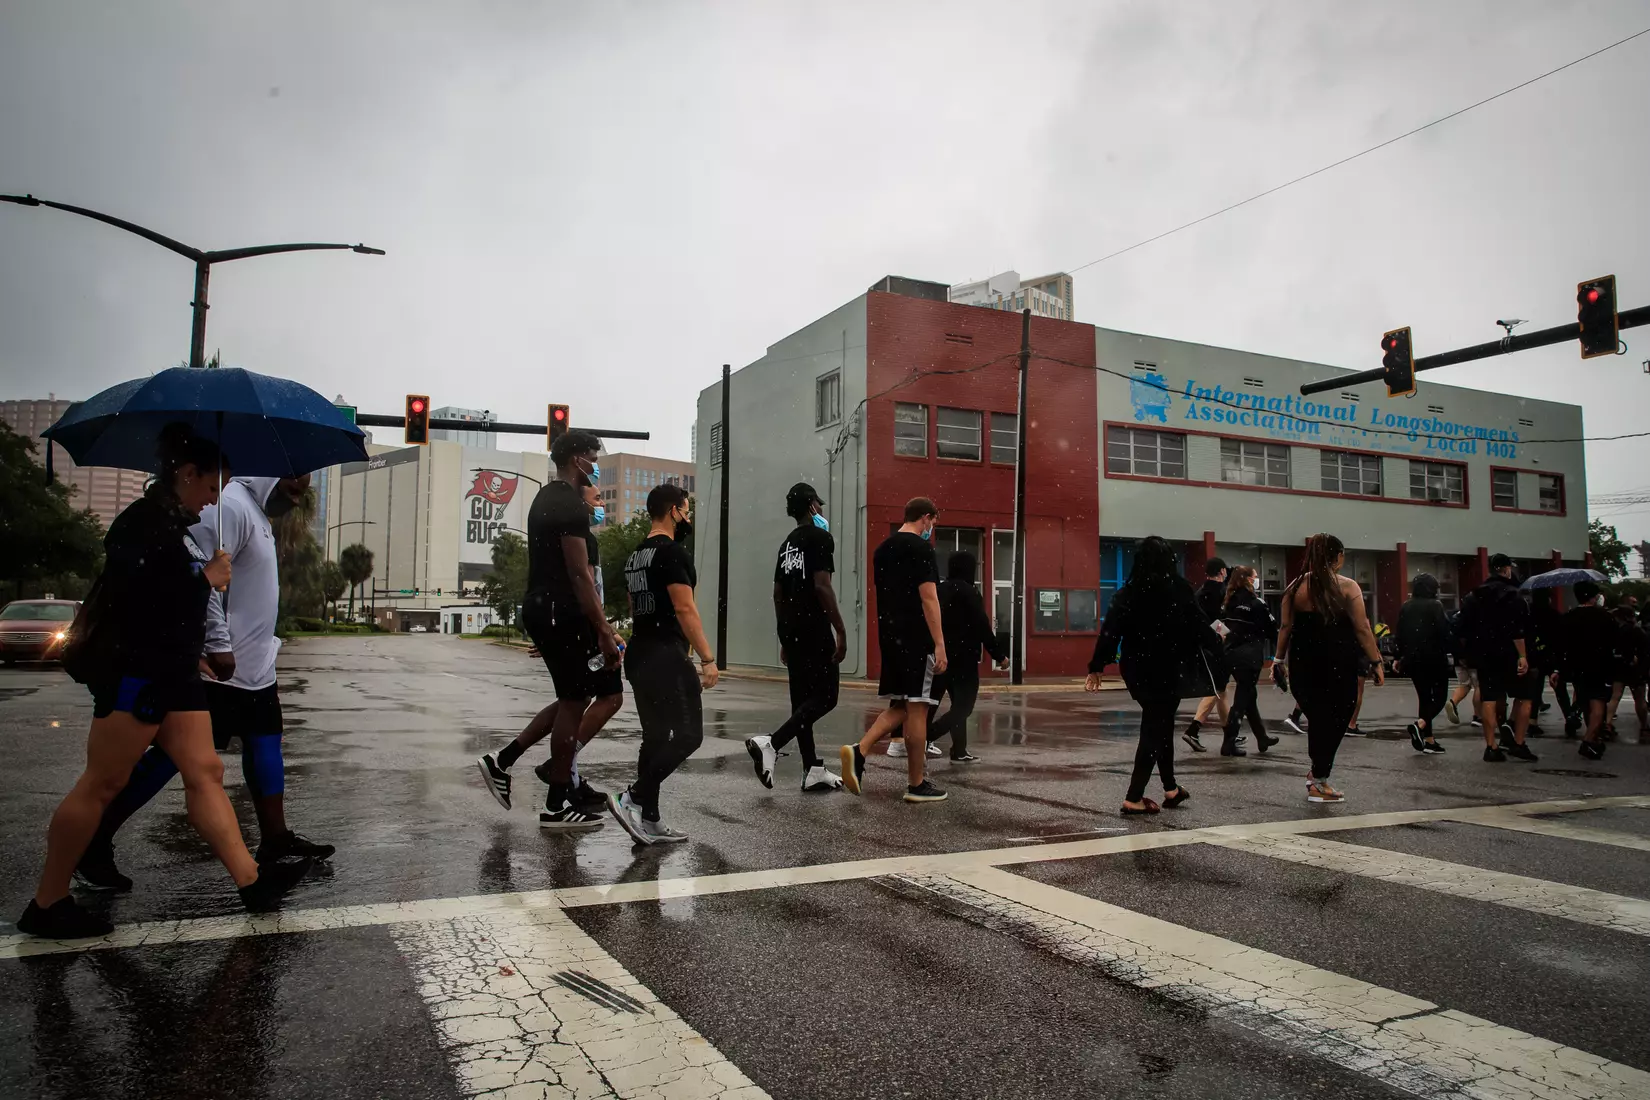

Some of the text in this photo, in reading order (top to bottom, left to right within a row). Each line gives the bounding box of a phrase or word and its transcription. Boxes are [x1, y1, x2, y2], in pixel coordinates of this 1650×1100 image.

[1182, 379, 1356, 422] International
[1184, 402, 1321, 434] Association
[1426, 434, 1477, 455] Local
[1486, 441, 1517, 459] 1402
[471, 496, 493, 520] GO
